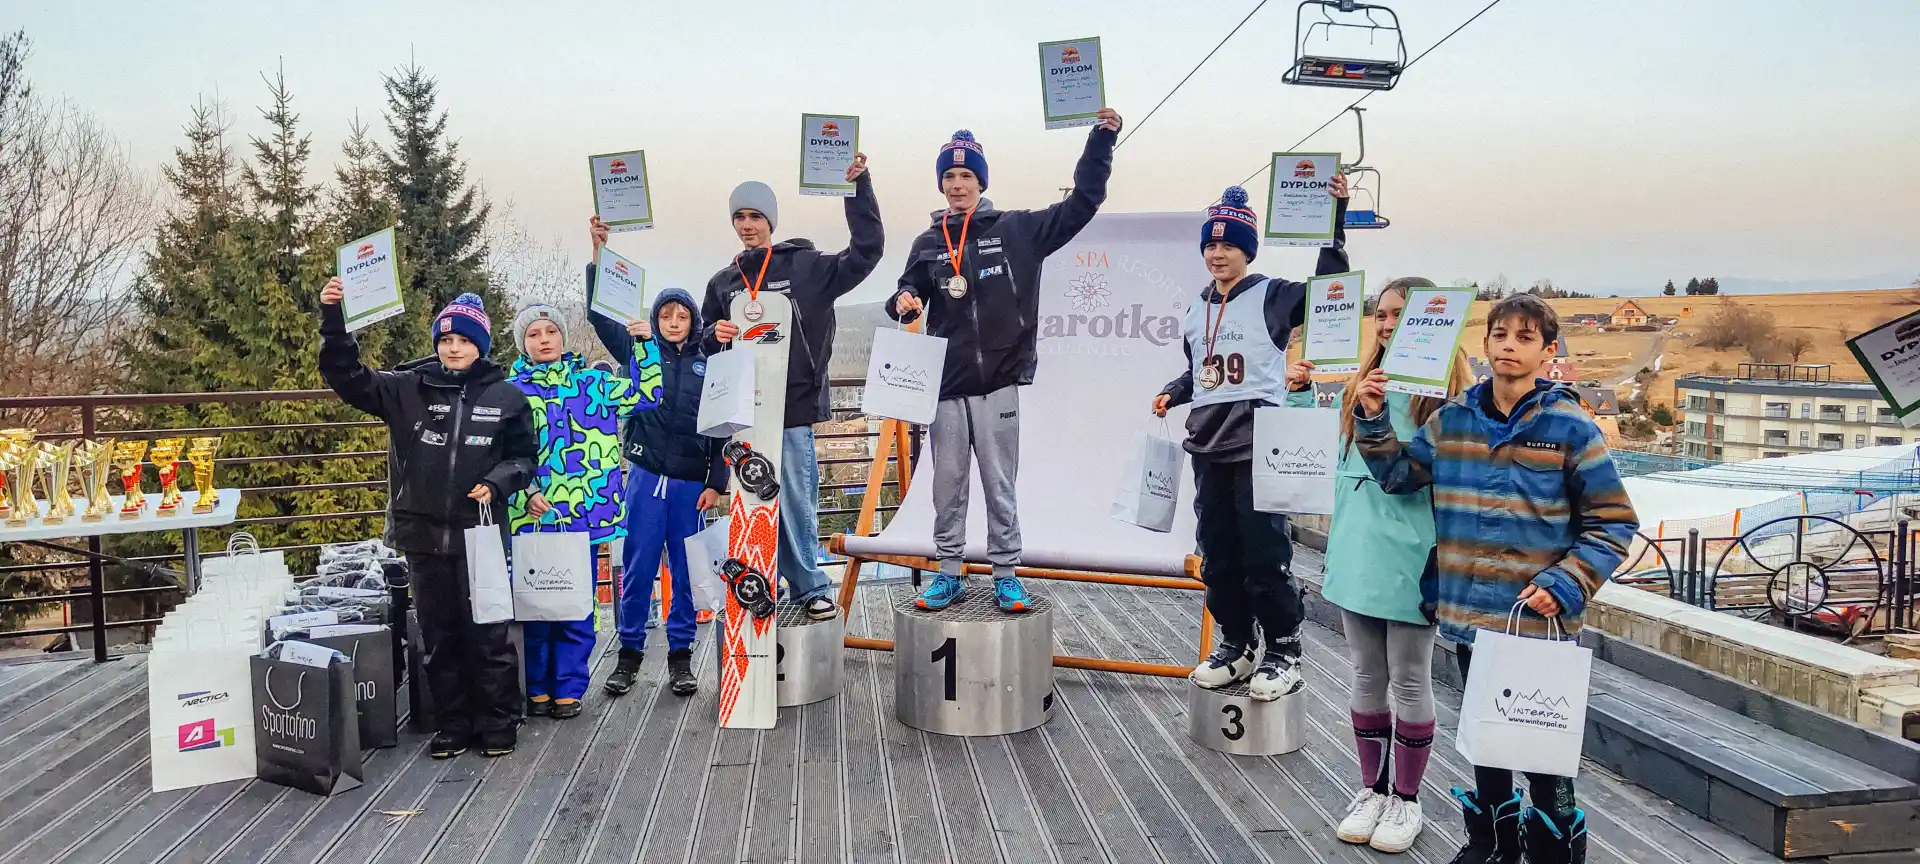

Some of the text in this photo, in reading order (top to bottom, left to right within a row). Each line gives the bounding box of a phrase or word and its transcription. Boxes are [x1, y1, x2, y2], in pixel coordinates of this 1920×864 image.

[1051, 64, 1093, 75] DYPLOM
[811, 138, 850, 147] DYPLOM
[601, 175, 639, 185] DYPLOM
[1280, 181, 1328, 189] DYPLOM
[346, 254, 386, 274] DYPLOM
[605, 267, 637, 289] DYPLOM
[1075, 250, 1110, 268] SPA
[1116, 255, 1186, 299] RESORT
[1315, 302, 1355, 314] DYPLOM
[1037, 304, 1182, 347] arotka
[1406, 317, 1455, 327] DYPLOM
[1880, 339, 1920, 361] DYP
[1000, 410, 1016, 419] PUMA
[630, 443, 643, 456] 22
[1526, 441, 1557, 449] BURTON
[931, 637, 957, 701] 1
[354, 680, 376, 701] ino
[1494, 697, 1569, 721] WINTERPOL
[1221, 704, 1245, 741] 3
[1508, 716, 1568, 730] www.winterpol.eu
